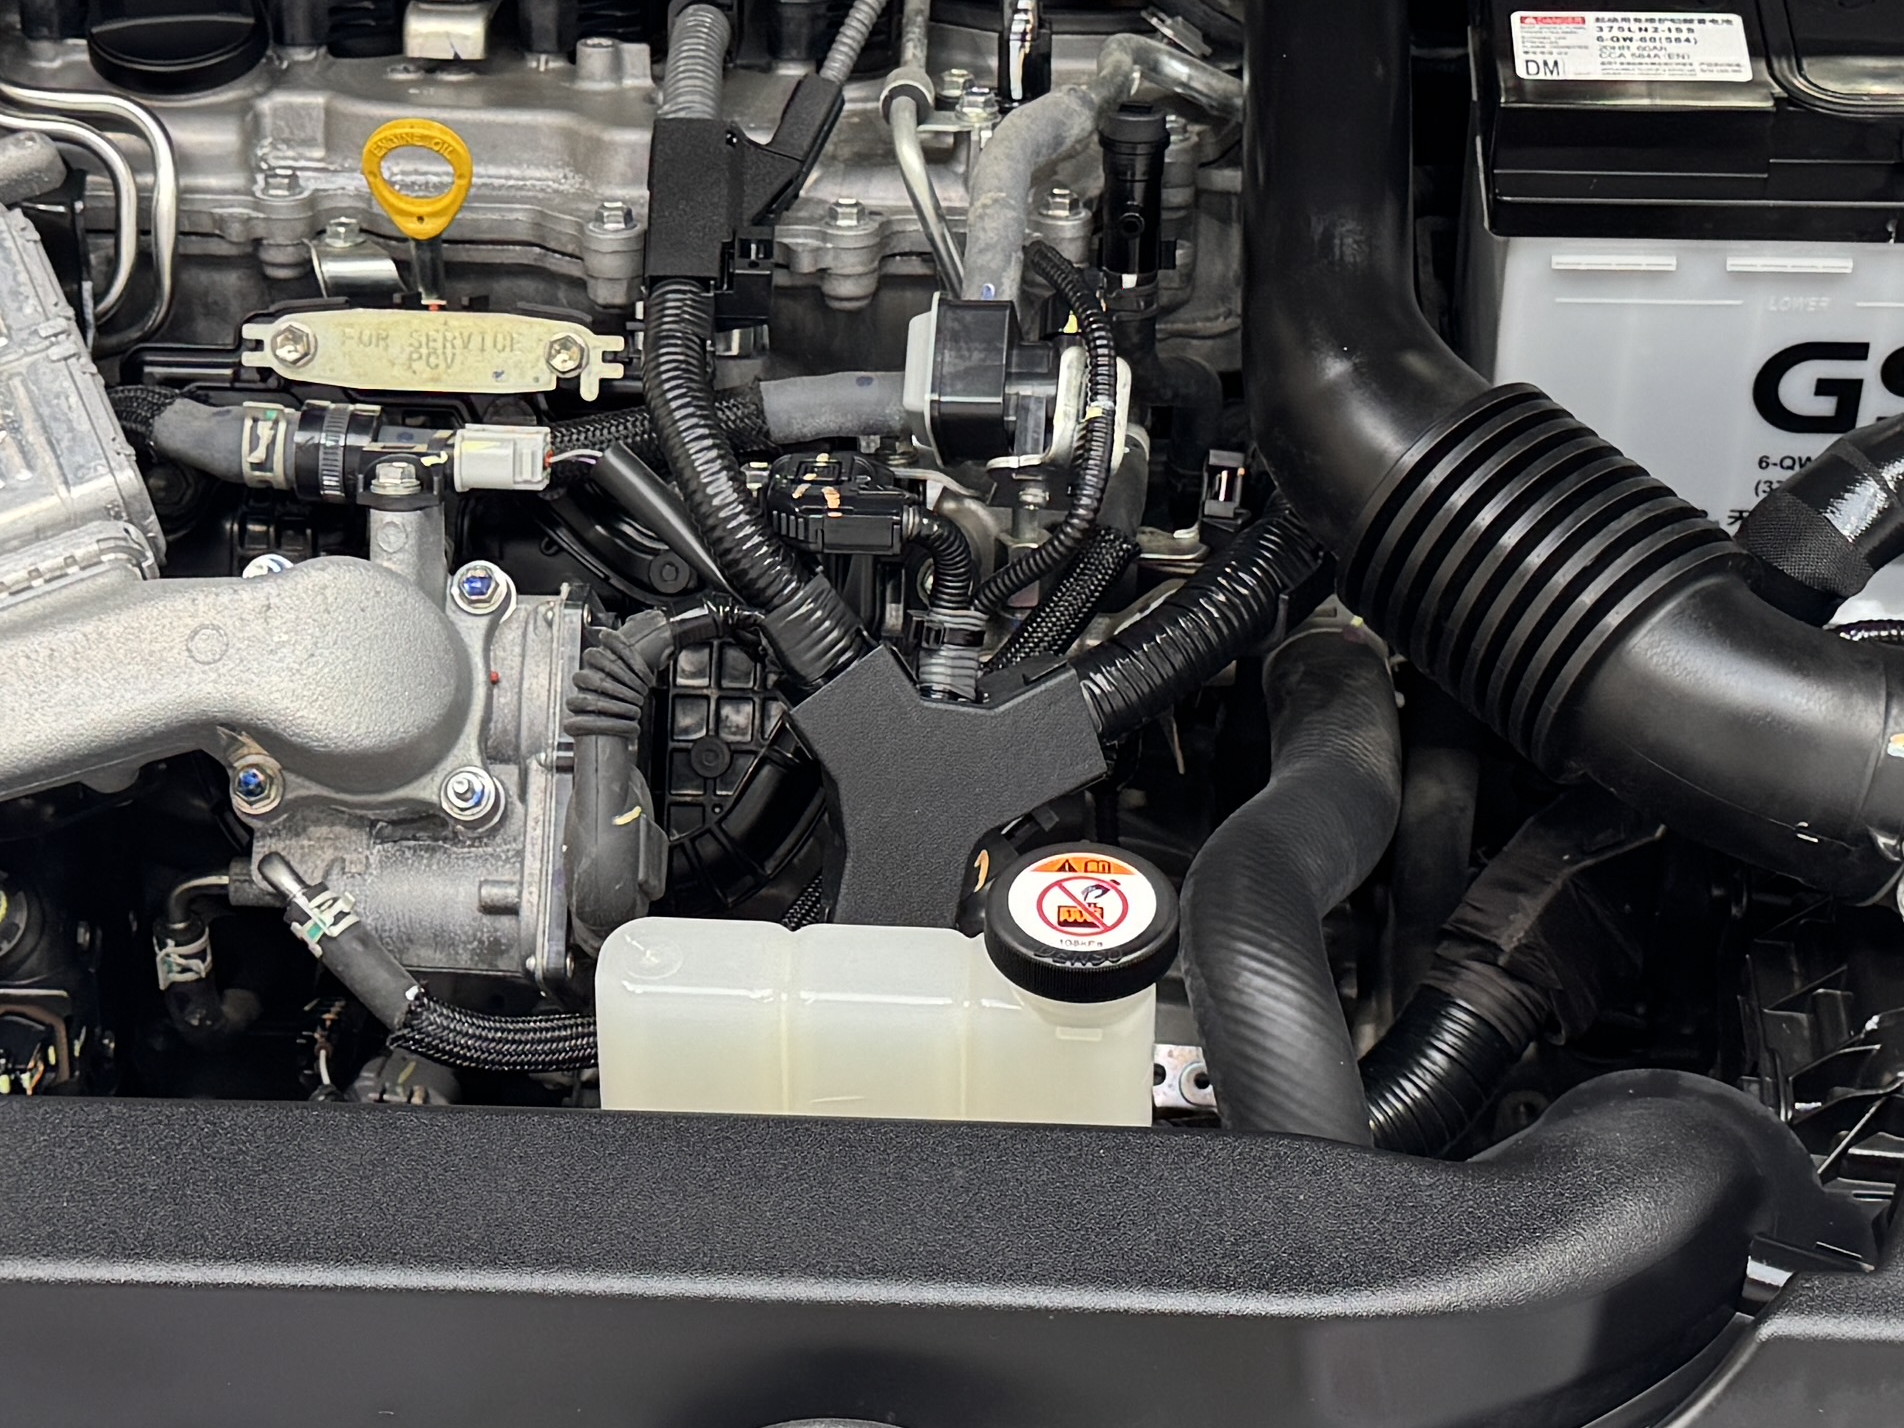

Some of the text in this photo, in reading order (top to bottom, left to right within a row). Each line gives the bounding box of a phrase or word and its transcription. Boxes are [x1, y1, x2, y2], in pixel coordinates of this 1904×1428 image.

[369, 132, 455, 160] ENGINE OIL
[1768, 295, 1832, 312] LOWER
[341, 328, 524, 353] FOR SERVICE
[408, 350, 458, 371] PCV
[1033, 946, 1123, 967] DENSO
